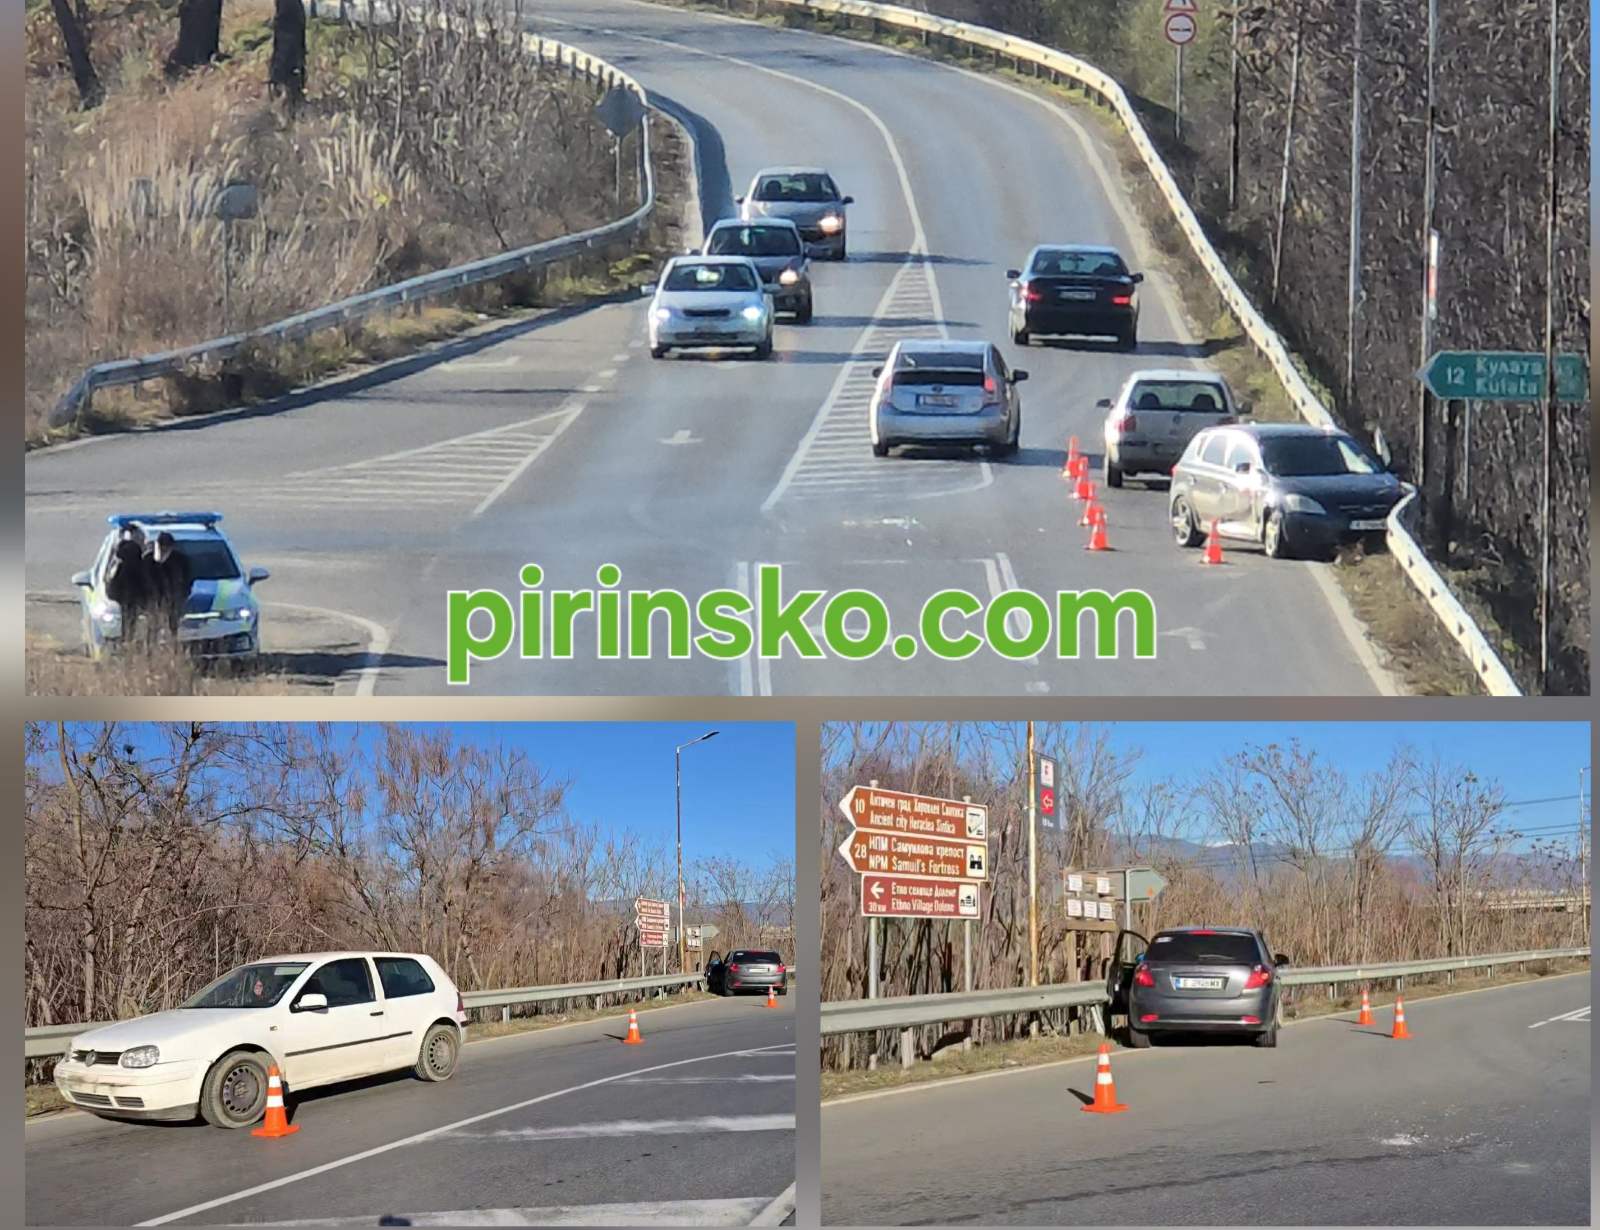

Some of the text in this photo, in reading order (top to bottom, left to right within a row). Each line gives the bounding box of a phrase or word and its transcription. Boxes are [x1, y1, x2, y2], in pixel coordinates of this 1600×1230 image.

[1446, 367, 1465, 385] 12
[855, 799, 865, 814] 10
[870, 810, 894, 826] Ancient
[896, 815, 908, 831] city
[854, 843, 867, 858] 28
[868, 835, 888, 851] НПМ
[868, 855, 960, 875] NPM Samuil's Fortress
